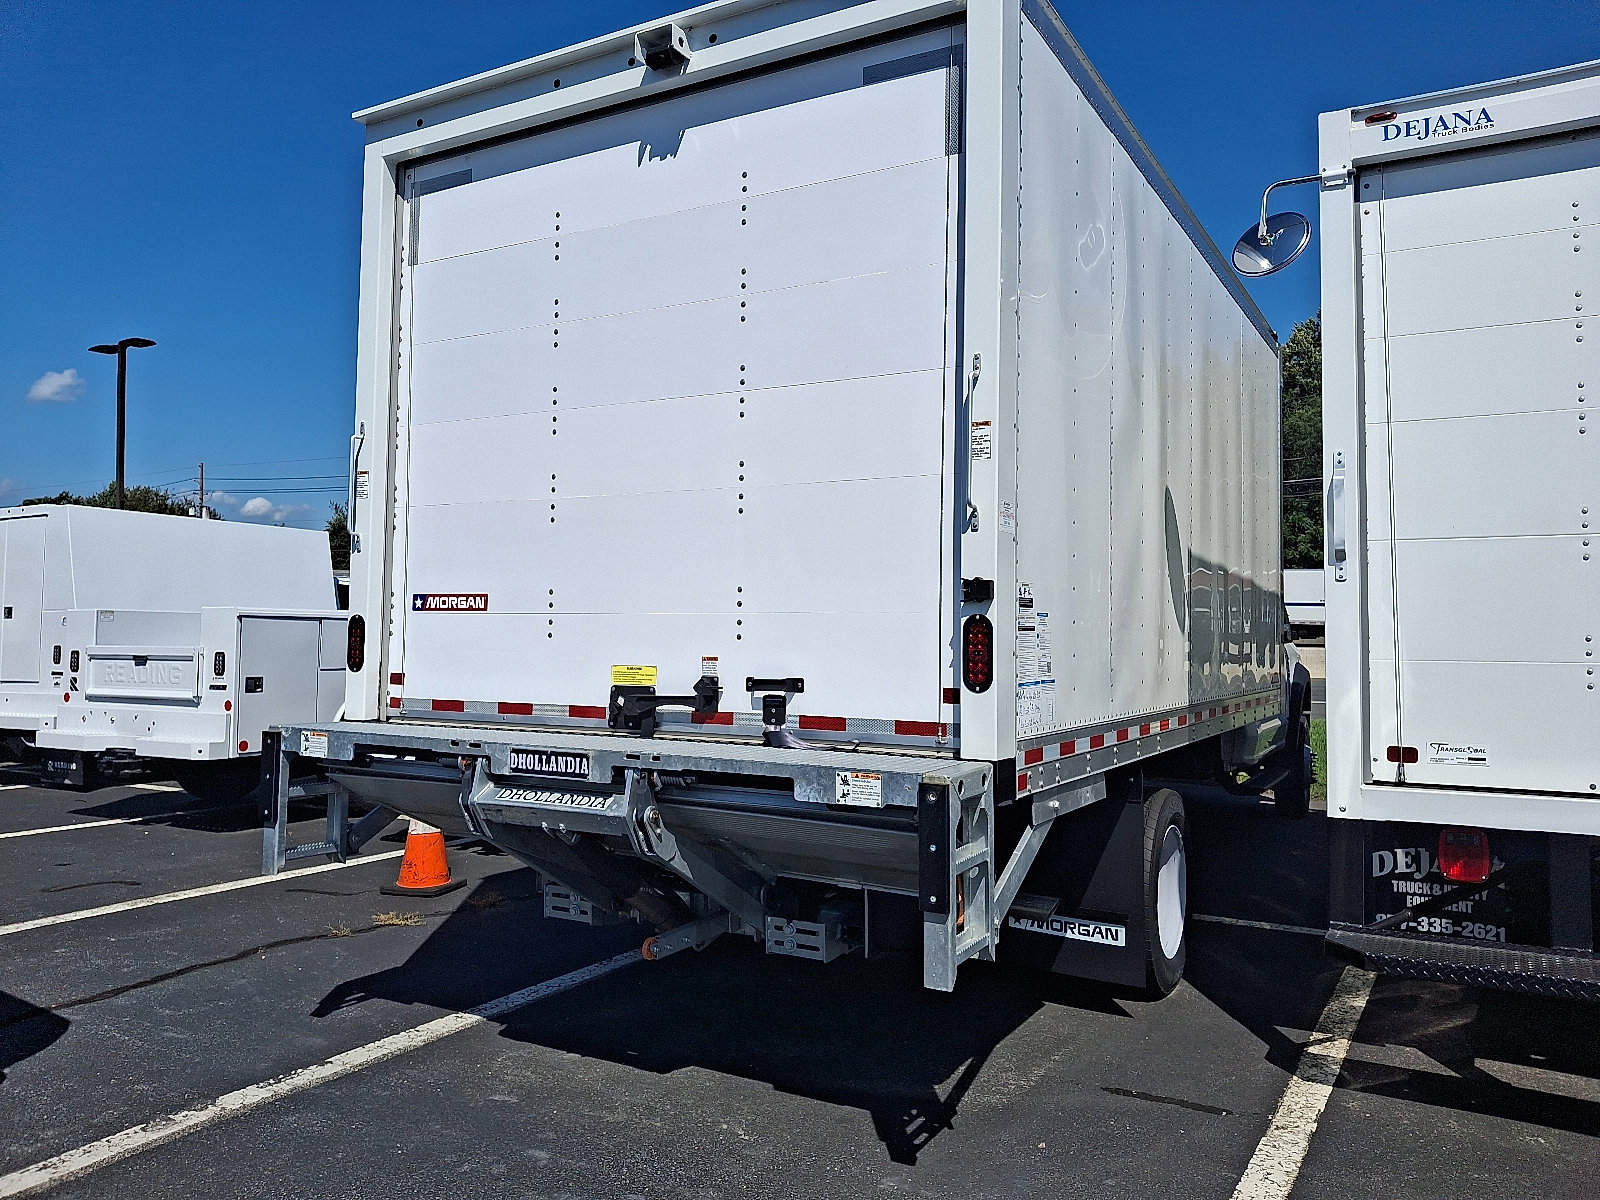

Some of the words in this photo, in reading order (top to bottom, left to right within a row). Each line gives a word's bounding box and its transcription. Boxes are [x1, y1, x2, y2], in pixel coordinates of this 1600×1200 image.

[1381, 107, 1494, 141] DEJANA
[1432, 129, 1458, 138] Truck
[1461, 123, 1495, 133] Bodies
[426, 596, 485, 609] MORGAN
[104, 663, 182, 685] READING
[510, 752, 589, 775] DHOLLANDIA
[498, 788, 611, 808] DHOLLANDIA
[1372, 848, 1506, 880] DEJ
[1391, 880, 1431, 895] TRUCK
[1432, 884, 1442, 896] &
[1030, 919, 1119, 941] MORGAN
